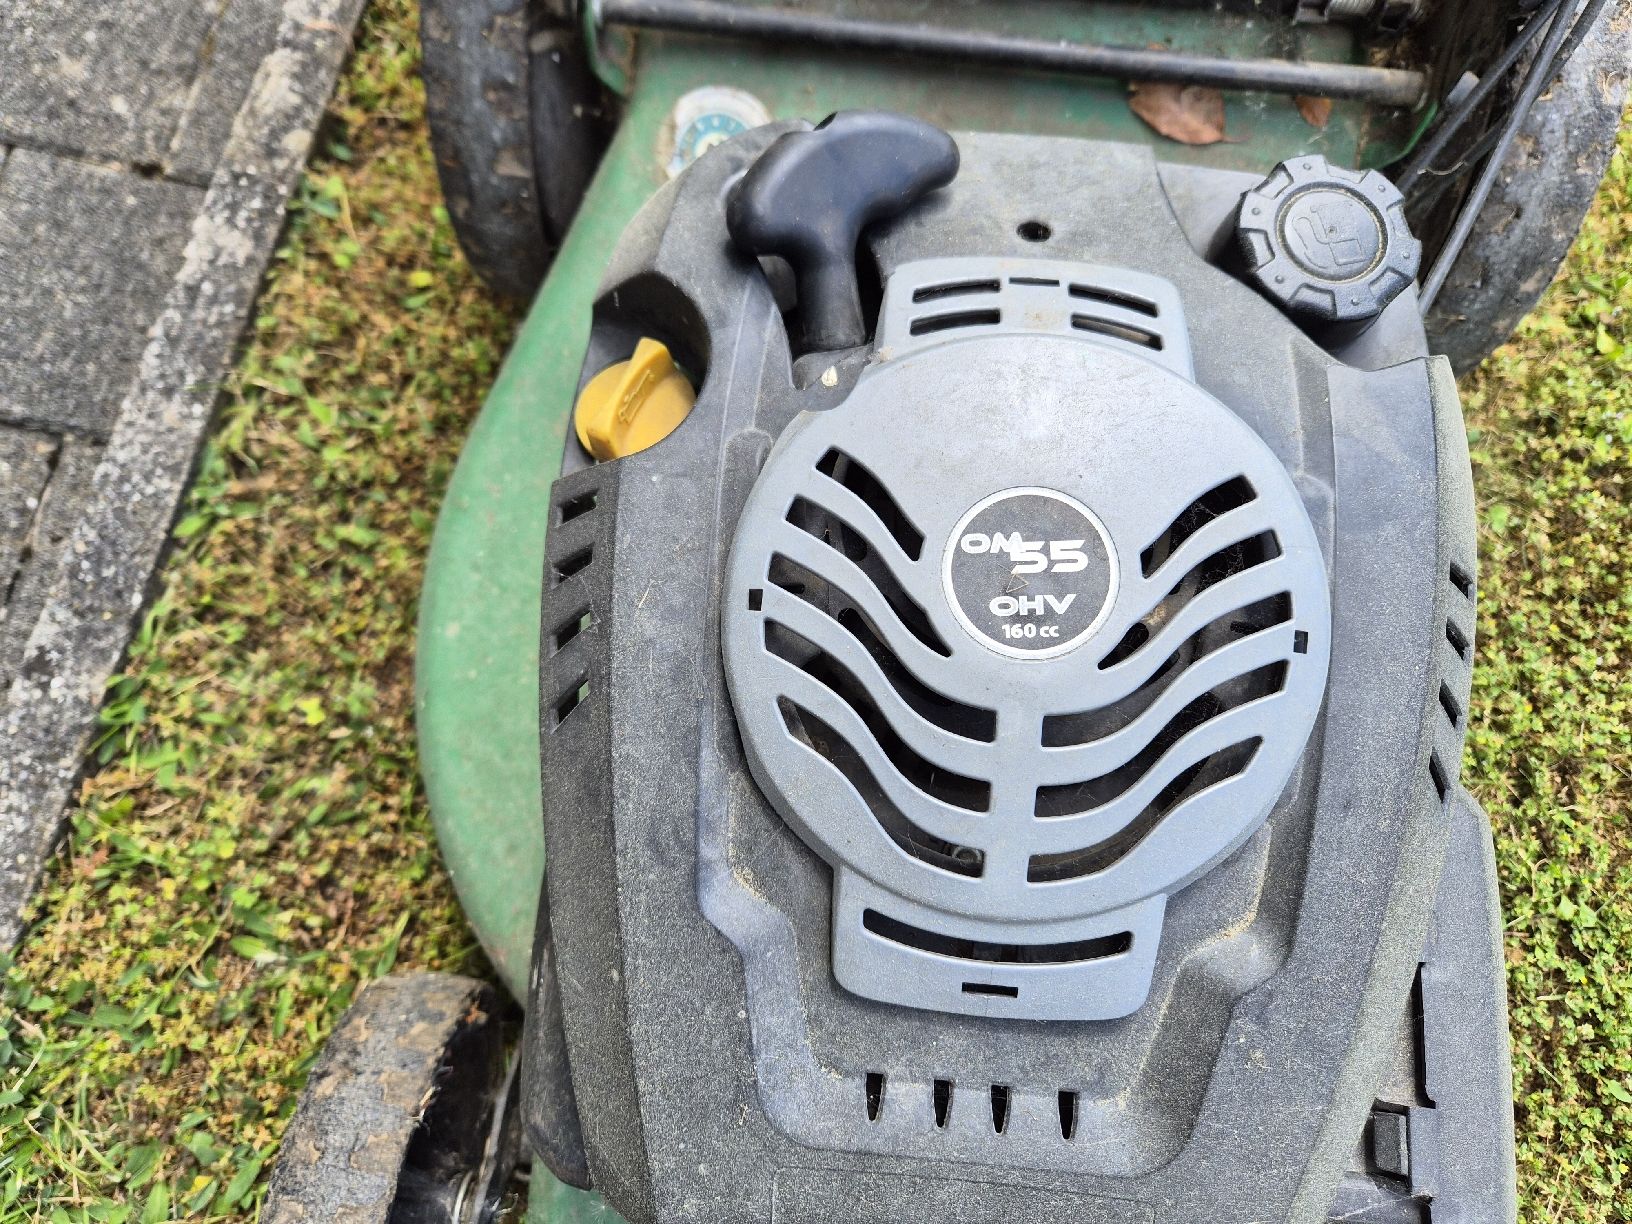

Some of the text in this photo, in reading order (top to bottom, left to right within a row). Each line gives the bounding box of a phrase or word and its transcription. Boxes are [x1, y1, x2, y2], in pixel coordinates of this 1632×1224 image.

[989, 594, 1077, 617] OHV
[1002, 623, 1060, 639] 160 cc
